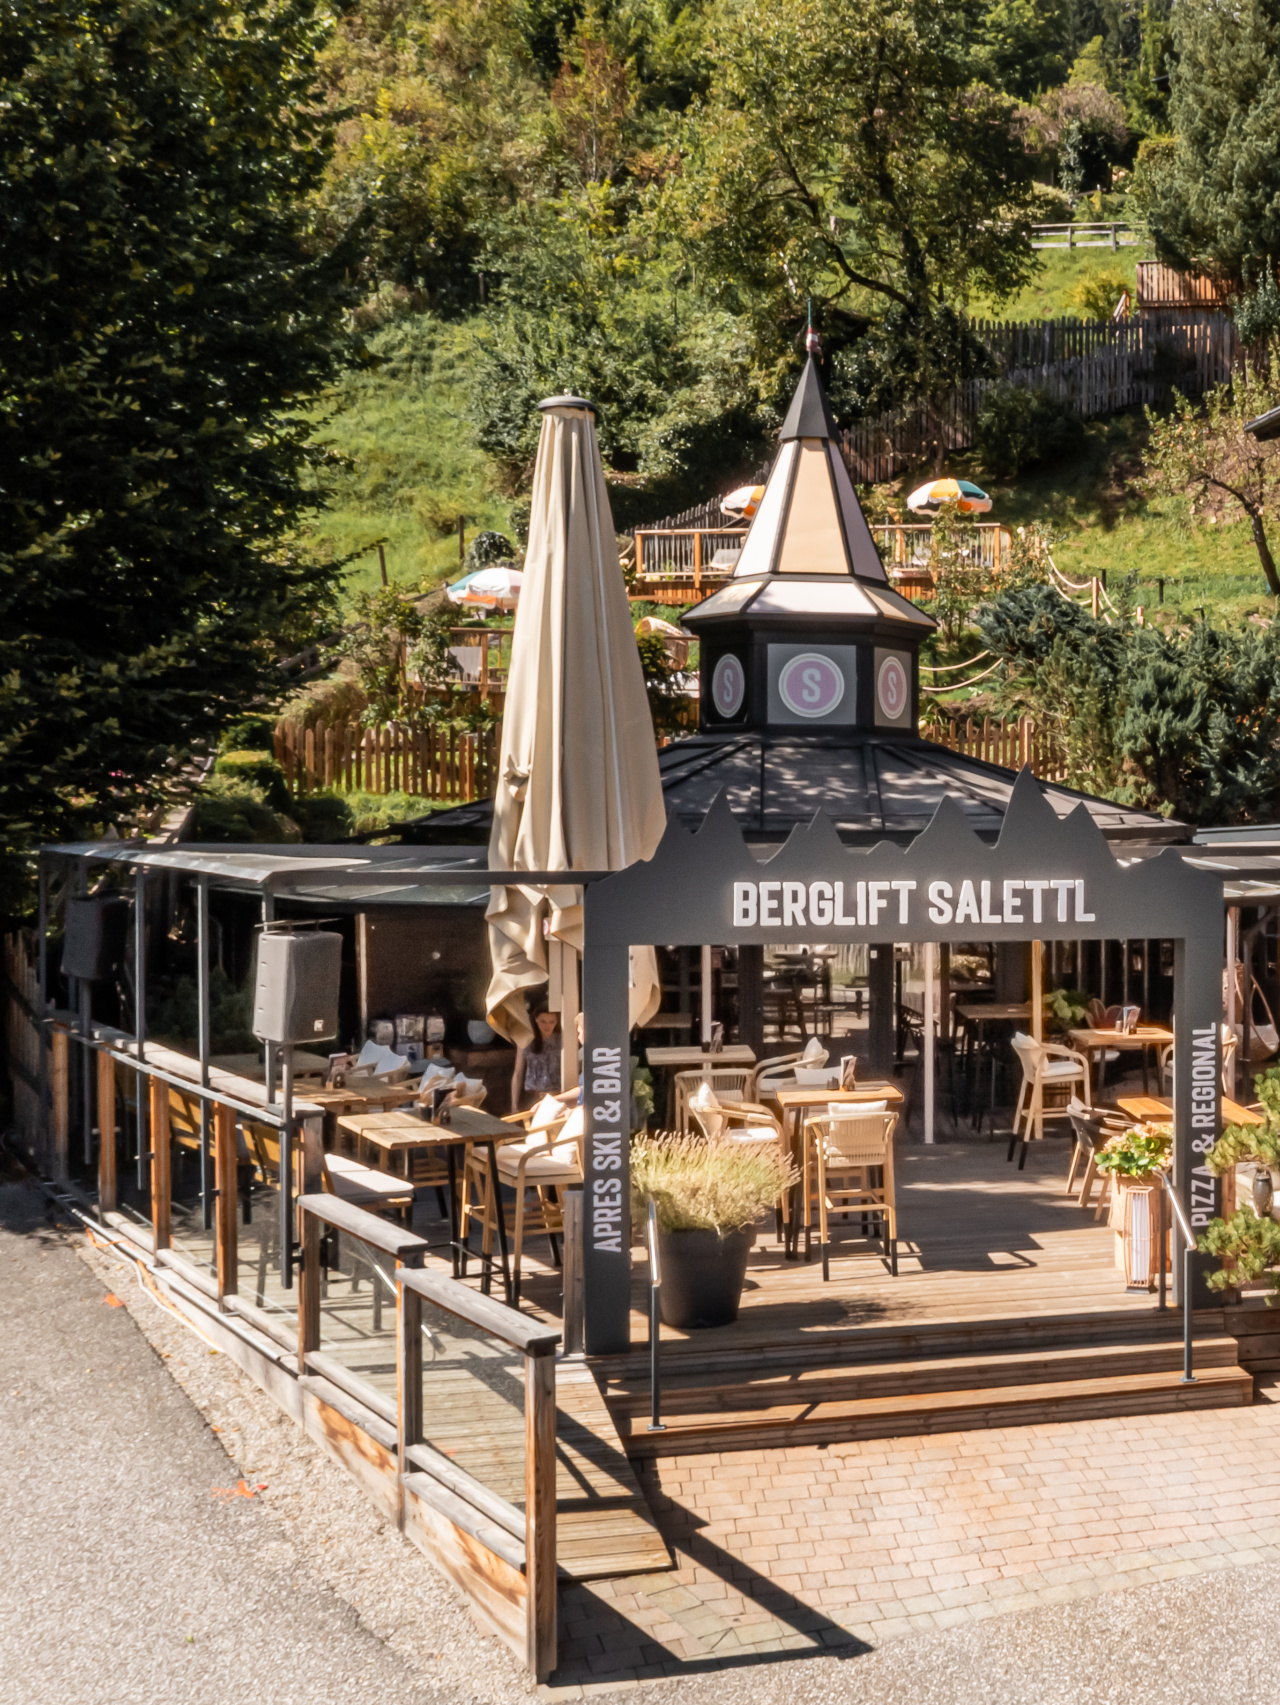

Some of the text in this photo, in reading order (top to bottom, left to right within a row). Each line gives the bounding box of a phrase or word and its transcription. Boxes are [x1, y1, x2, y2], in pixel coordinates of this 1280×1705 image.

[723, 668, 733, 703] S
[802, 667, 821, 703] S
[887, 670, 897, 705] S
[732, 879, 1096, 927] BERGLIFT SALETTL
[1190, 1021, 1216, 1227] PIZZA & REGIONAL
[592, 1047, 622, 1253] APRES SKI & BAR
